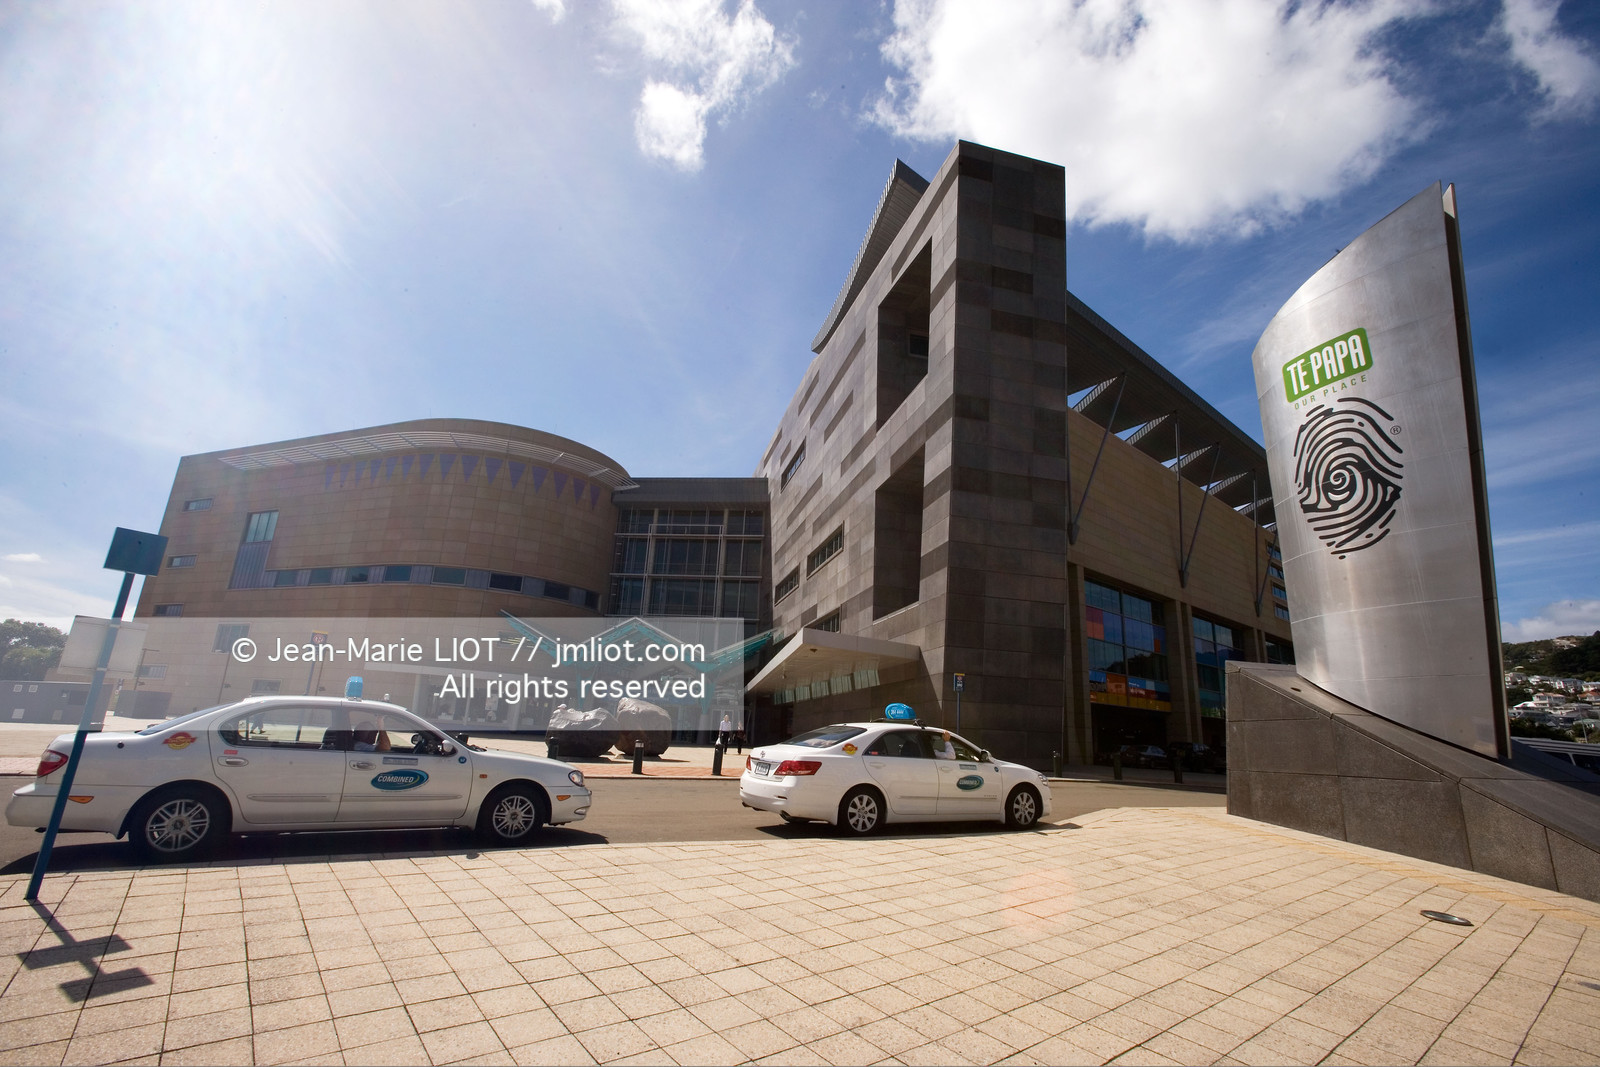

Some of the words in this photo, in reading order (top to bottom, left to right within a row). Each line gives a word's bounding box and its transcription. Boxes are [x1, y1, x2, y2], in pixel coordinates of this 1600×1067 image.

[1286, 358, 1310, 395] TE
[1309, 334, 1367, 385] PAPA
[1294, 395, 1317, 410] OUR
[1323, 374, 1368, 397] PLACE
[377, 775, 415, 783] COMBINED
